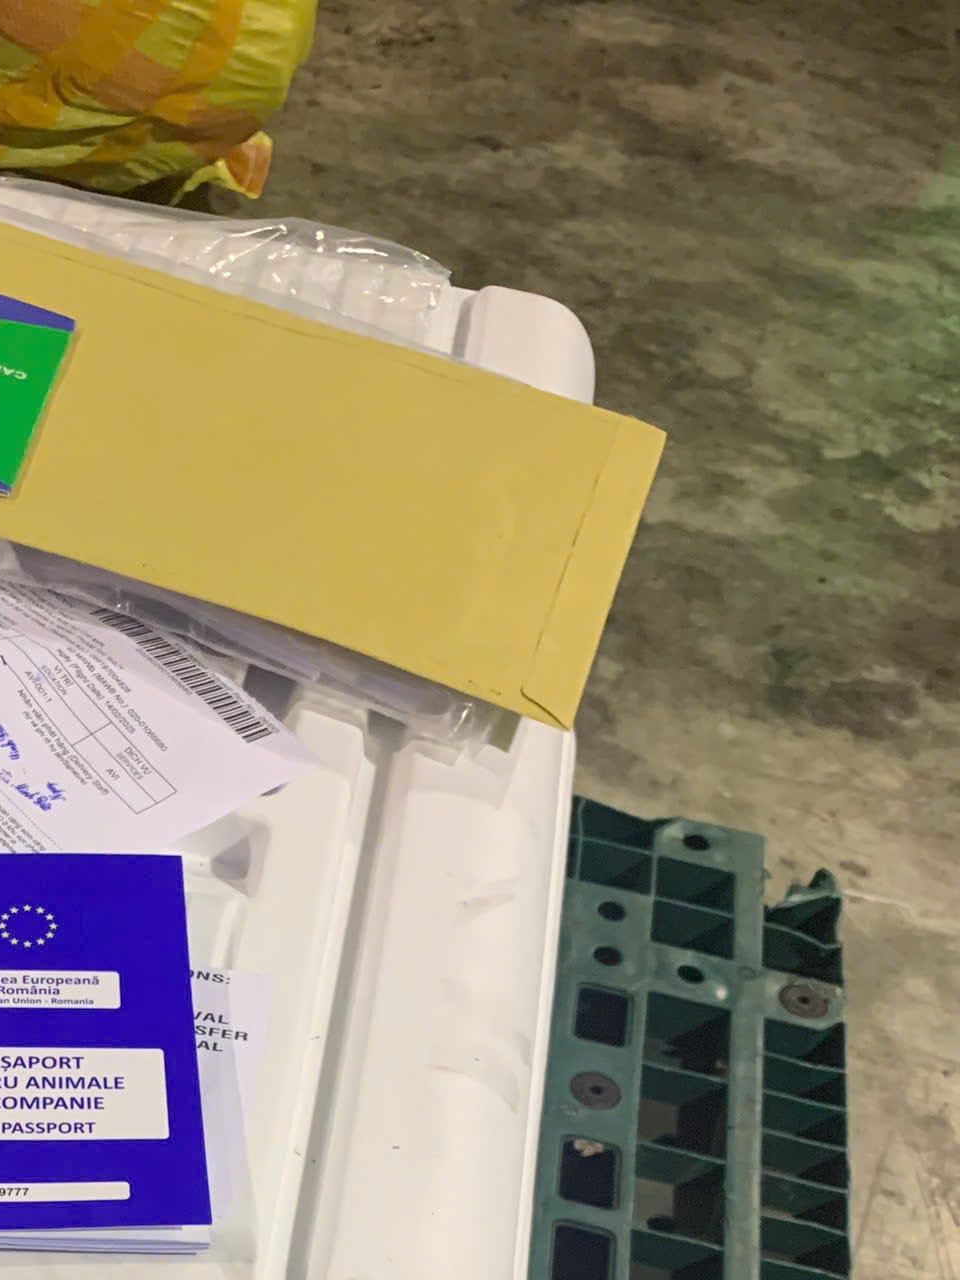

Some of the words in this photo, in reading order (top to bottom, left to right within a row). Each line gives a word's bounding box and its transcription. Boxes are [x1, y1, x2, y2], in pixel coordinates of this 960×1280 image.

[22, 974, 100, 986] Europeană
[13, 997, 43, 1006] Union
[51, 997, 95, 1006] Romania
[25, 1075, 125, 1090] ANIMALE
[1, 1121, 96, 1134] PASSPORT
